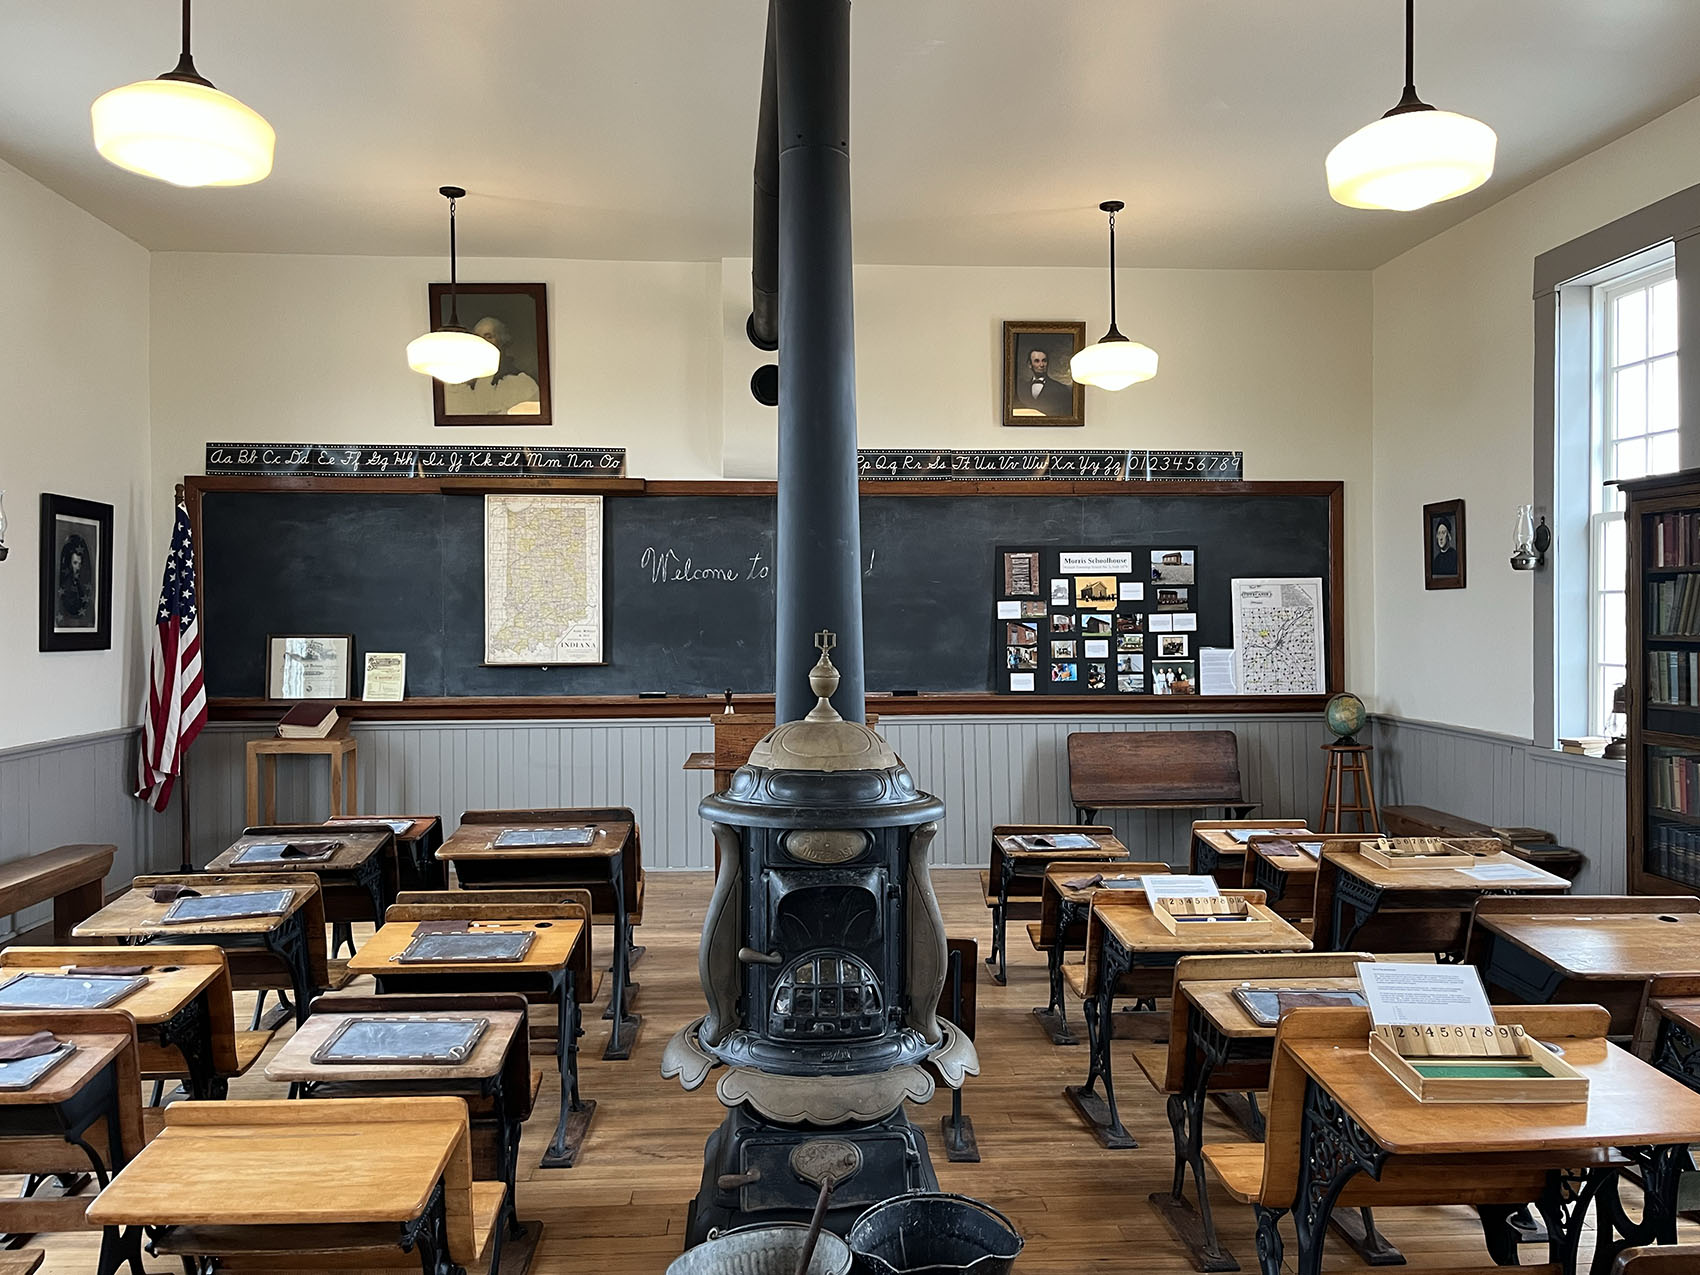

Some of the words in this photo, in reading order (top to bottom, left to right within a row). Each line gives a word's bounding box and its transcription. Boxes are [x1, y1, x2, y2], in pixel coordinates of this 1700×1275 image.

[210, 449, 233, 464] Aa
[238, 449, 258, 464] Bb
[262, 449, 281, 464] Cc
[285, 448, 309, 464] Dd
[317, 450, 335, 465] Ee
[340, 450, 361, 471] Ff
[366, 451, 389, 471] Gg
[393, 451, 414, 466] Hh
[422, 452, 444, 466] Ii
[449, 452, 463, 472] Jj
[468, 452, 493, 467] Kk
[498, 452, 520, 467] Ll
[526, 453, 561, 468] Mm
[567, 453, 594, 468] Nn
[599, 454, 621, 468] Oo
[875, 455, 898, 475] Qq
[902, 455, 922, 470] Rr
[926, 455, 946, 470] Ss
[952, 455, 971, 470] Tt
[974, 455, 997, 470] Uu
[999, 455, 1020, 470] Vv
[1022, 455, 1048, 470] Ww
[1050, 455, 1076, 470] Xx
[1079, 455, 1100, 476] Yy
[1103, 455, 1122, 476] Zz
[641, 547, 739, 583] Welcome
[746, 552, 769, 579] to
[1384, 1027, 1389, 1038] 1
[1398, 1027, 1406, 1038] 2
[1412, 1026, 1420, 1037] 3
[1425, 1027, 1434, 1038] 4
[1440, 1027, 1449, 1038] 5
[1454, 1027, 1464, 1038] 6
[1469, 1028, 1477, 1038] 7
[1484, 1027, 1494, 1038] 8
[1500, 1028, 1508, 1038] 9
[1512, 1026, 1524, 1037] 10
